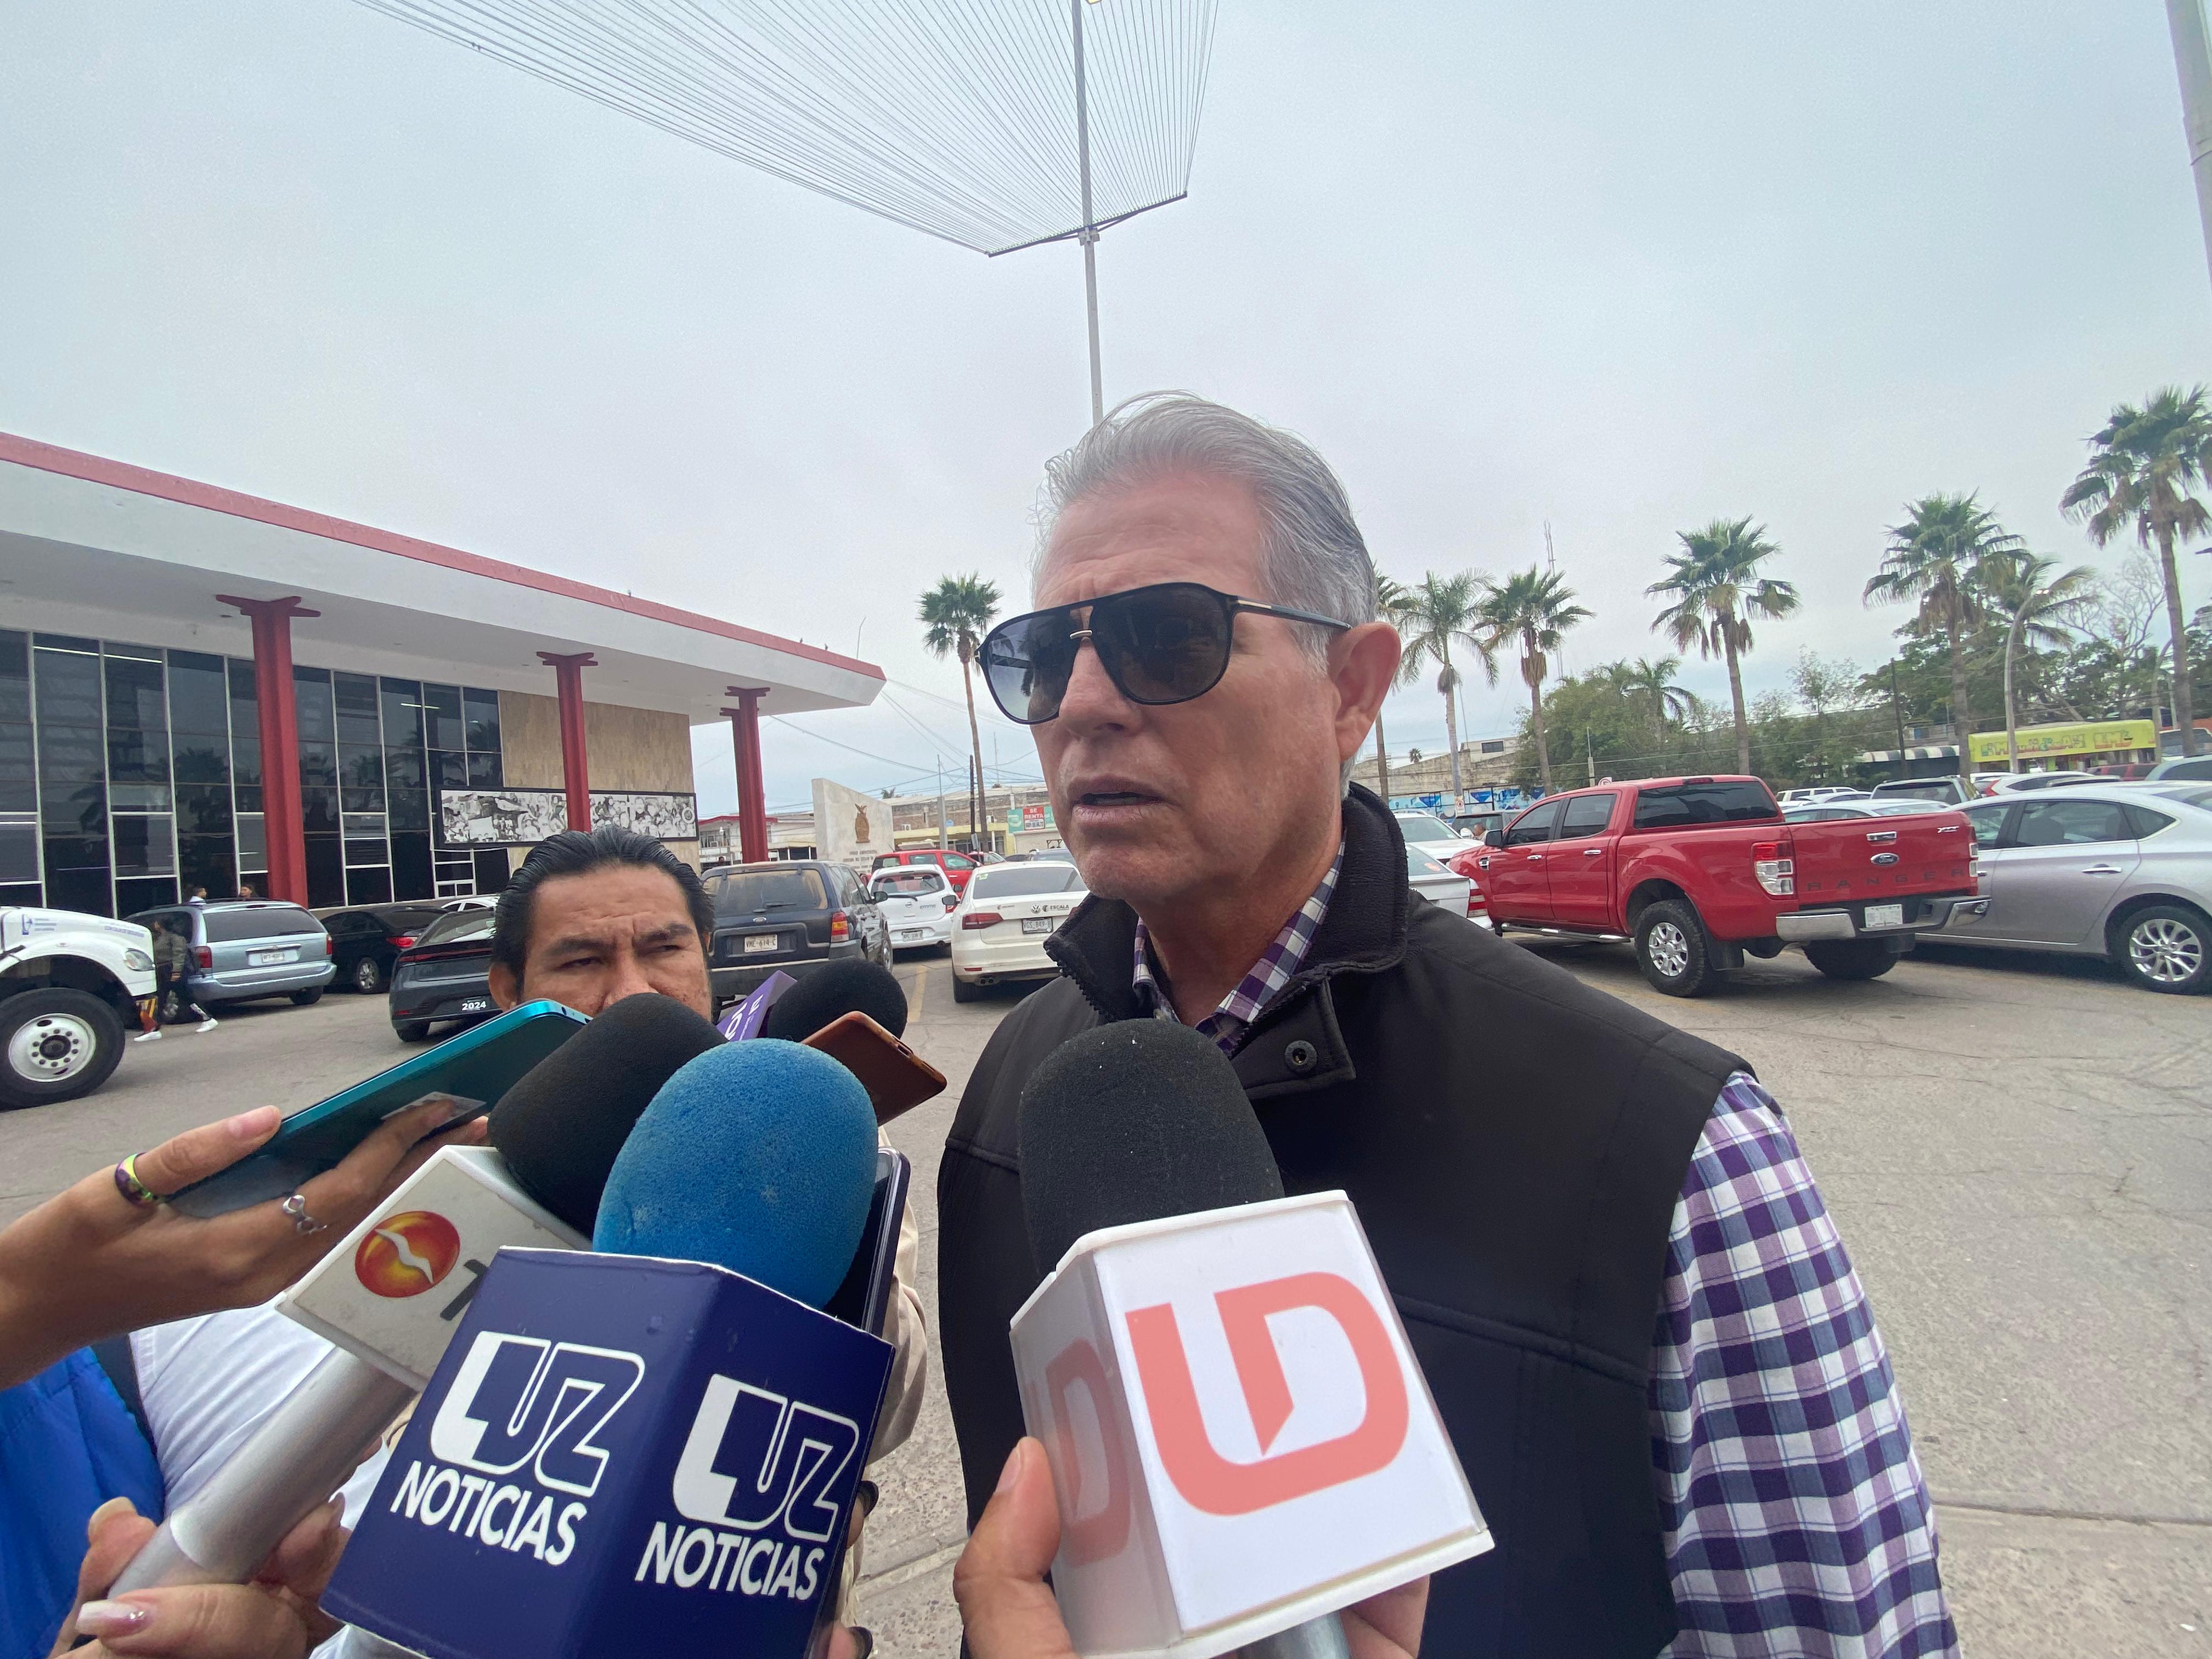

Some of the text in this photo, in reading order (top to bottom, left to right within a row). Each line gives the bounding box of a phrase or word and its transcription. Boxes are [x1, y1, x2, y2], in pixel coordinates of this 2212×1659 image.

[1807, 869, 1964, 891] RANGER
[462, 1001, 487, 1011] 2024
[430, 1331, 645, 1498] LUZ
[673, 1374, 860, 1543] LUZ
[390, 1460, 588, 1566] NOTICIAS
[635, 1521, 825, 1600] NOTICIAS
